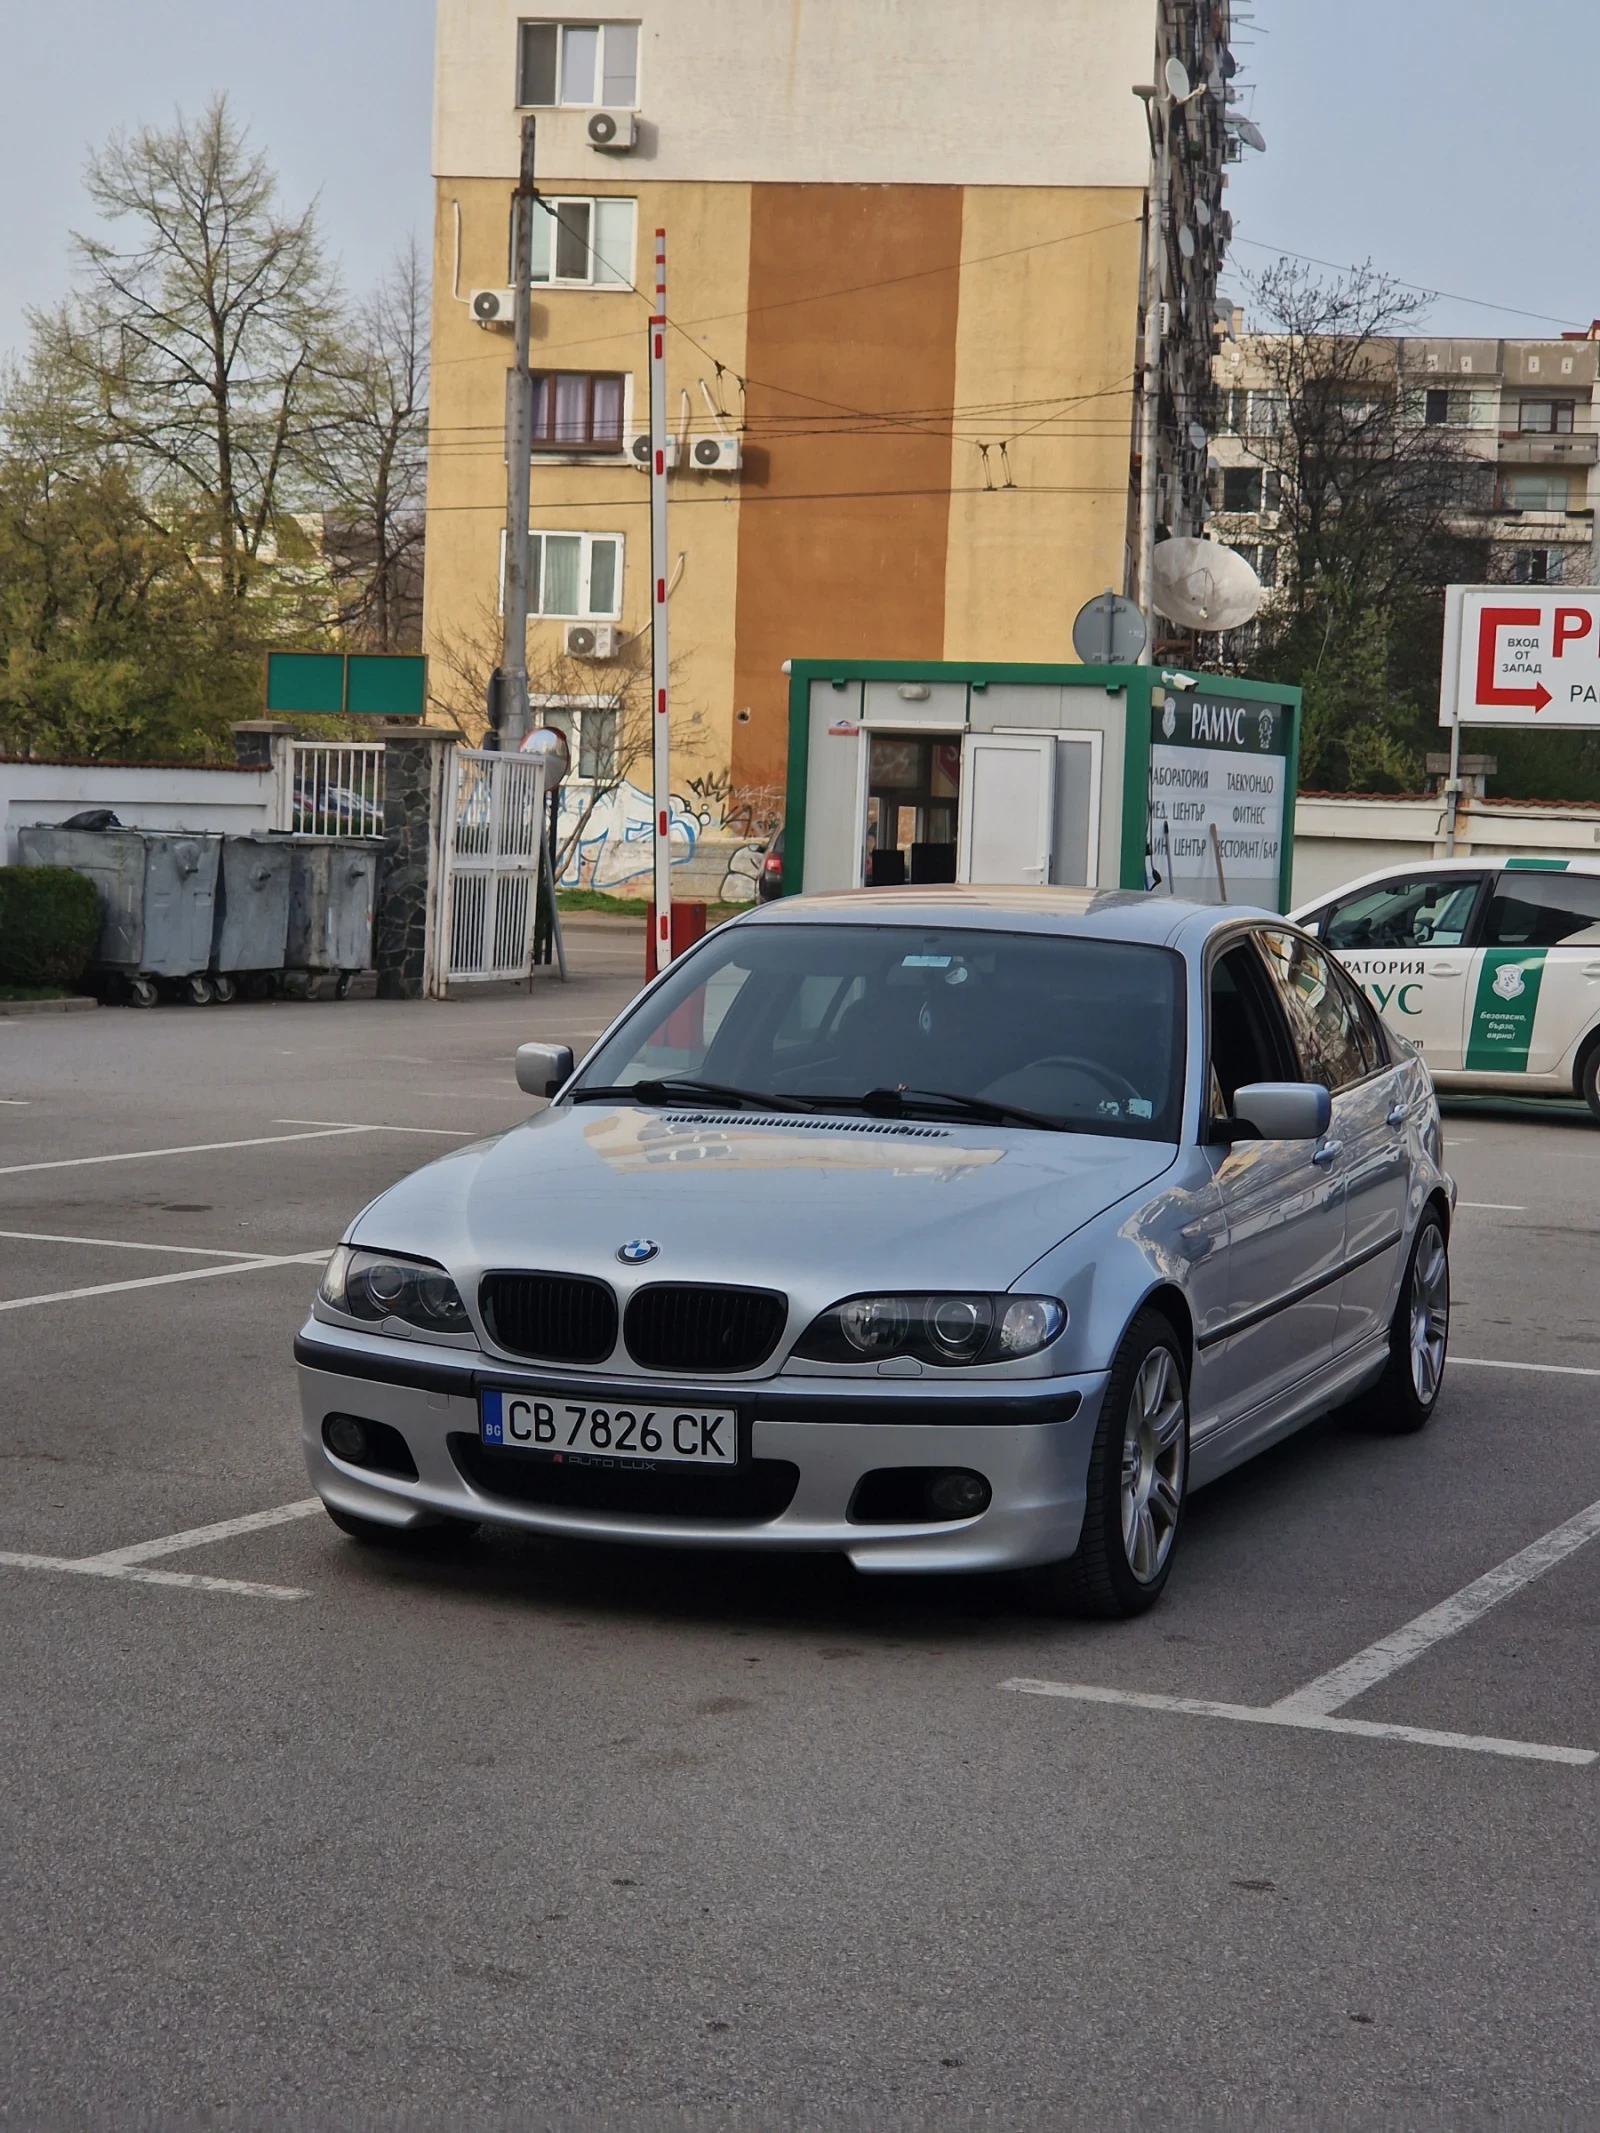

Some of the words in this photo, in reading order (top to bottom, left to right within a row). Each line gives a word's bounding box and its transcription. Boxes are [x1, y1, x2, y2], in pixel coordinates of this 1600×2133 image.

[1552, 607, 1600, 658] Р
[1507, 638, 1539, 649] ВХОД
[1515, 651, 1531, 660] ОТ
[1502, 663, 1542, 674] ЗАПАД
[1570, 684, 1600, 703] РА
[1191, 703, 1246, 745] РАМУС
[1150, 766, 1209, 789] АБОРАТОРИЯ
[1227, 772, 1274, 794] ТАЕКУОНДО
[1173, 802, 1206, 822] ЦЕНТЪР
[1232, 806, 1266, 825] ФИТНЕС
[1174, 838, 1207, 857] ЦЕНТЪР
[1360, 983, 1424, 1015] УС
[1480, 1011, 1526, 1022] Безопасно,
[1488, 1021, 1516, 1031] бързо,
[1486, 1032, 1516, 1040] вярно!
[485, 1423, 502, 1437] BG
[508, 1400, 557, 1443] CB
[565, 1405, 663, 1452] 7826
[673, 1413, 726, 1457] CK
[568, 1456, 614, 1468] AUTO
[620, 1460, 656, 1471] LUX
